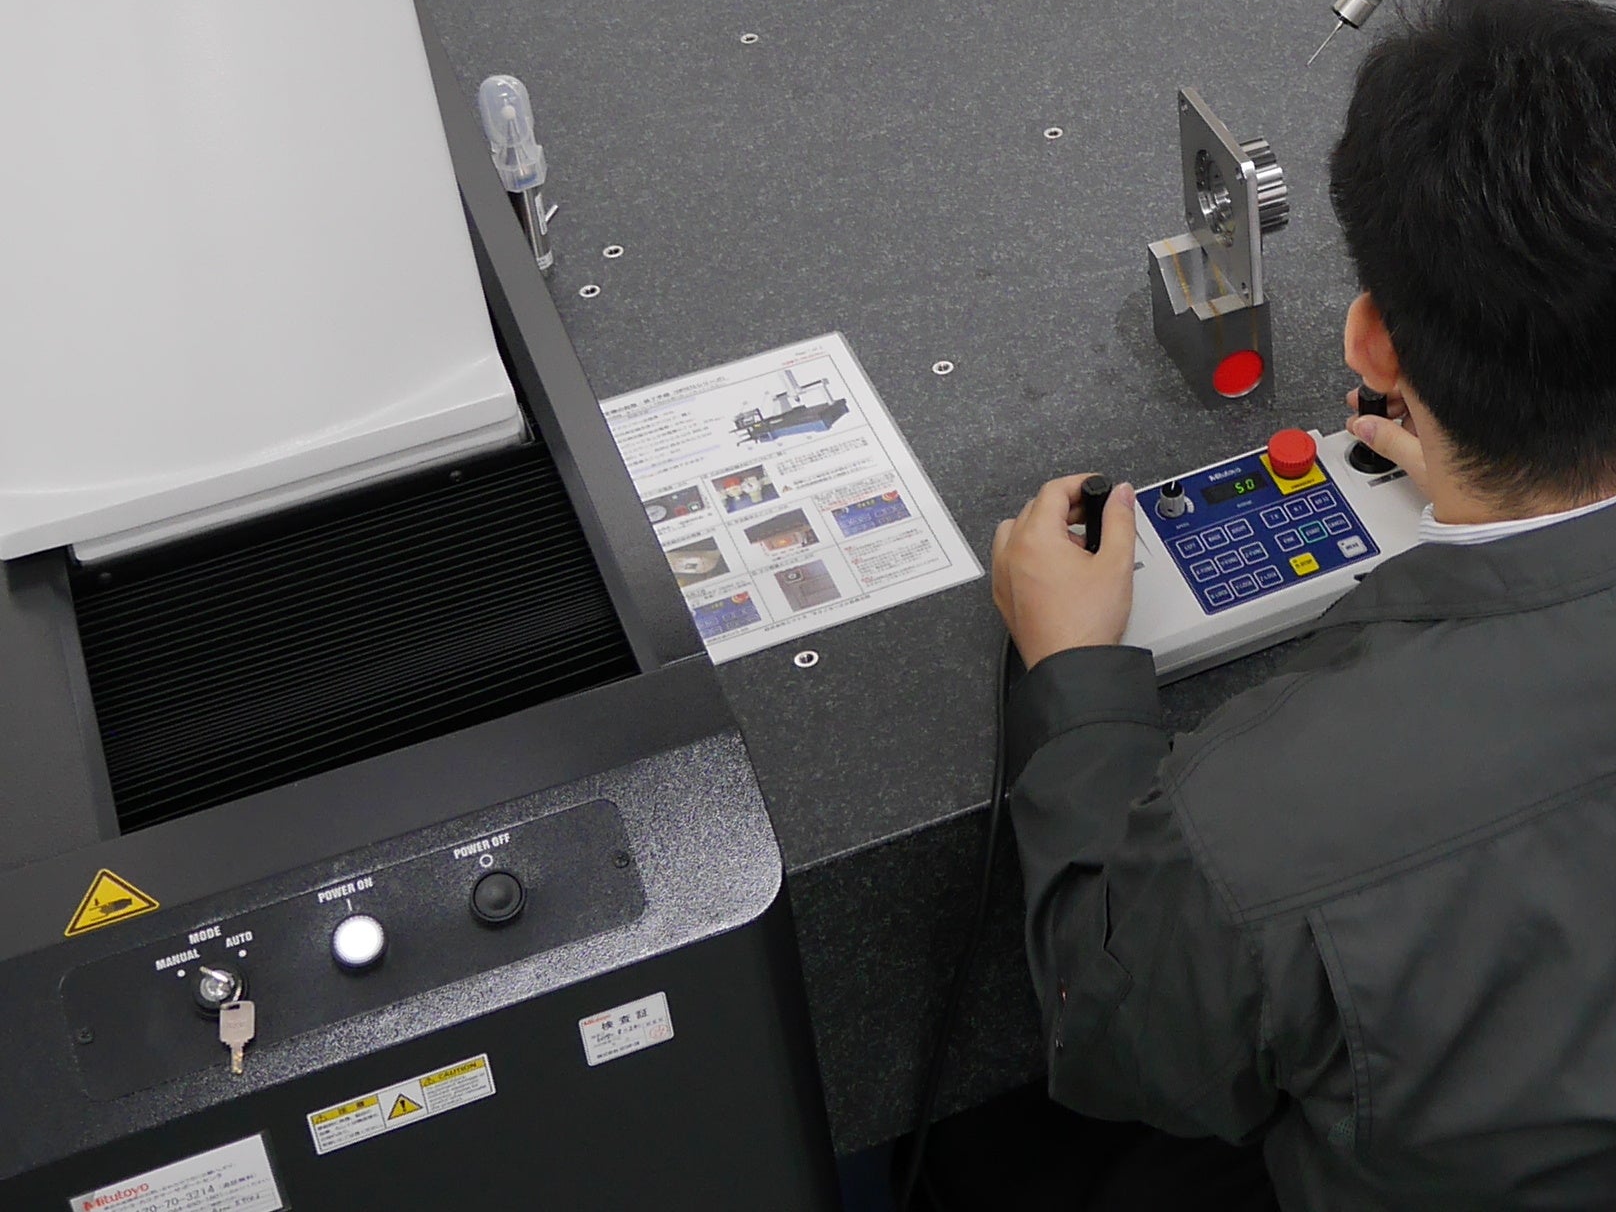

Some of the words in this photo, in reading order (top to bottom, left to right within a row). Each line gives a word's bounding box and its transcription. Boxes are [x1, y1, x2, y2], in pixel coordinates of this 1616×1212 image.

[1234, 478, 1256, 494] 50
[453, 840, 490, 860] POWER
[491, 833, 512, 850] OFF
[317, 881, 357, 904] POWER
[356, 876, 374, 894] ON
[188, 926, 222, 945] MODE
[225, 931, 254, 949] AUTO
[155, 948, 201, 971] MANUAL
[82, 1182, 150, 1212] Mitutoyo
